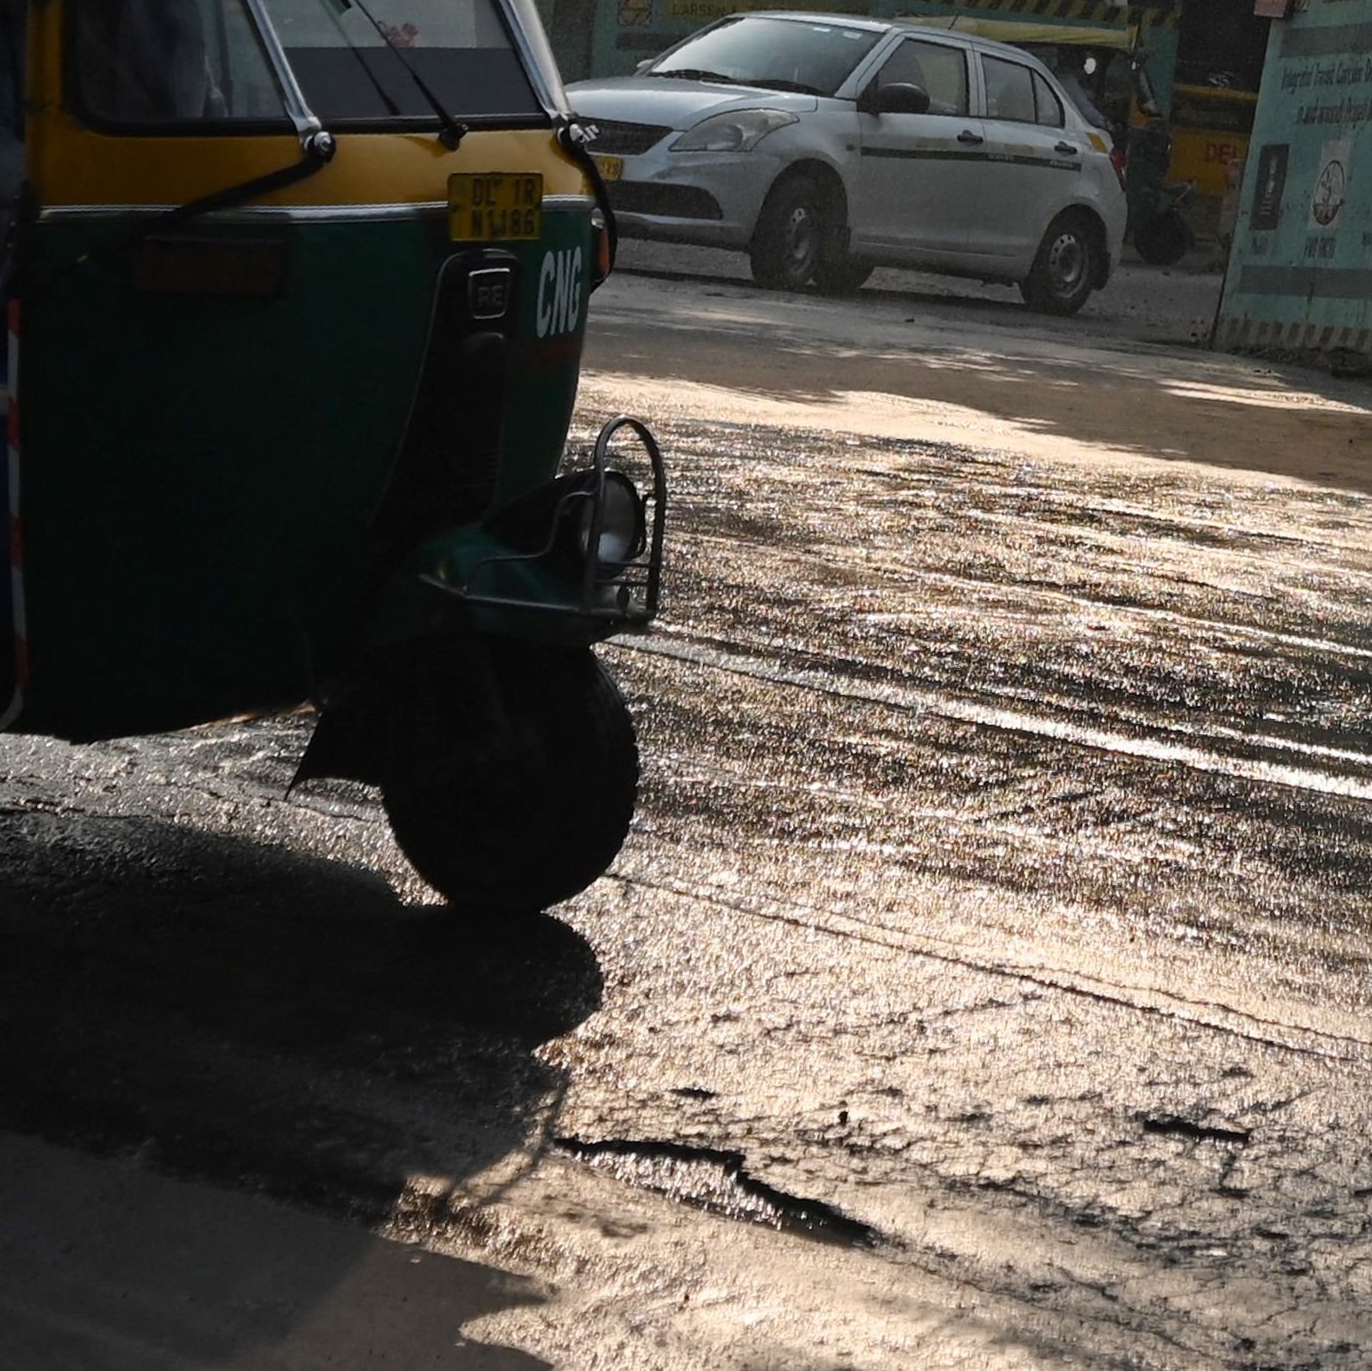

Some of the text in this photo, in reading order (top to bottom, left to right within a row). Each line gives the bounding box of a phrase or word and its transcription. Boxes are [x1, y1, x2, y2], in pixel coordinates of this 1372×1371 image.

[472, 178, 535, 205] DL 1R
[478, 284, 504, 307] RE
[536, 246, 582, 339] CNG
